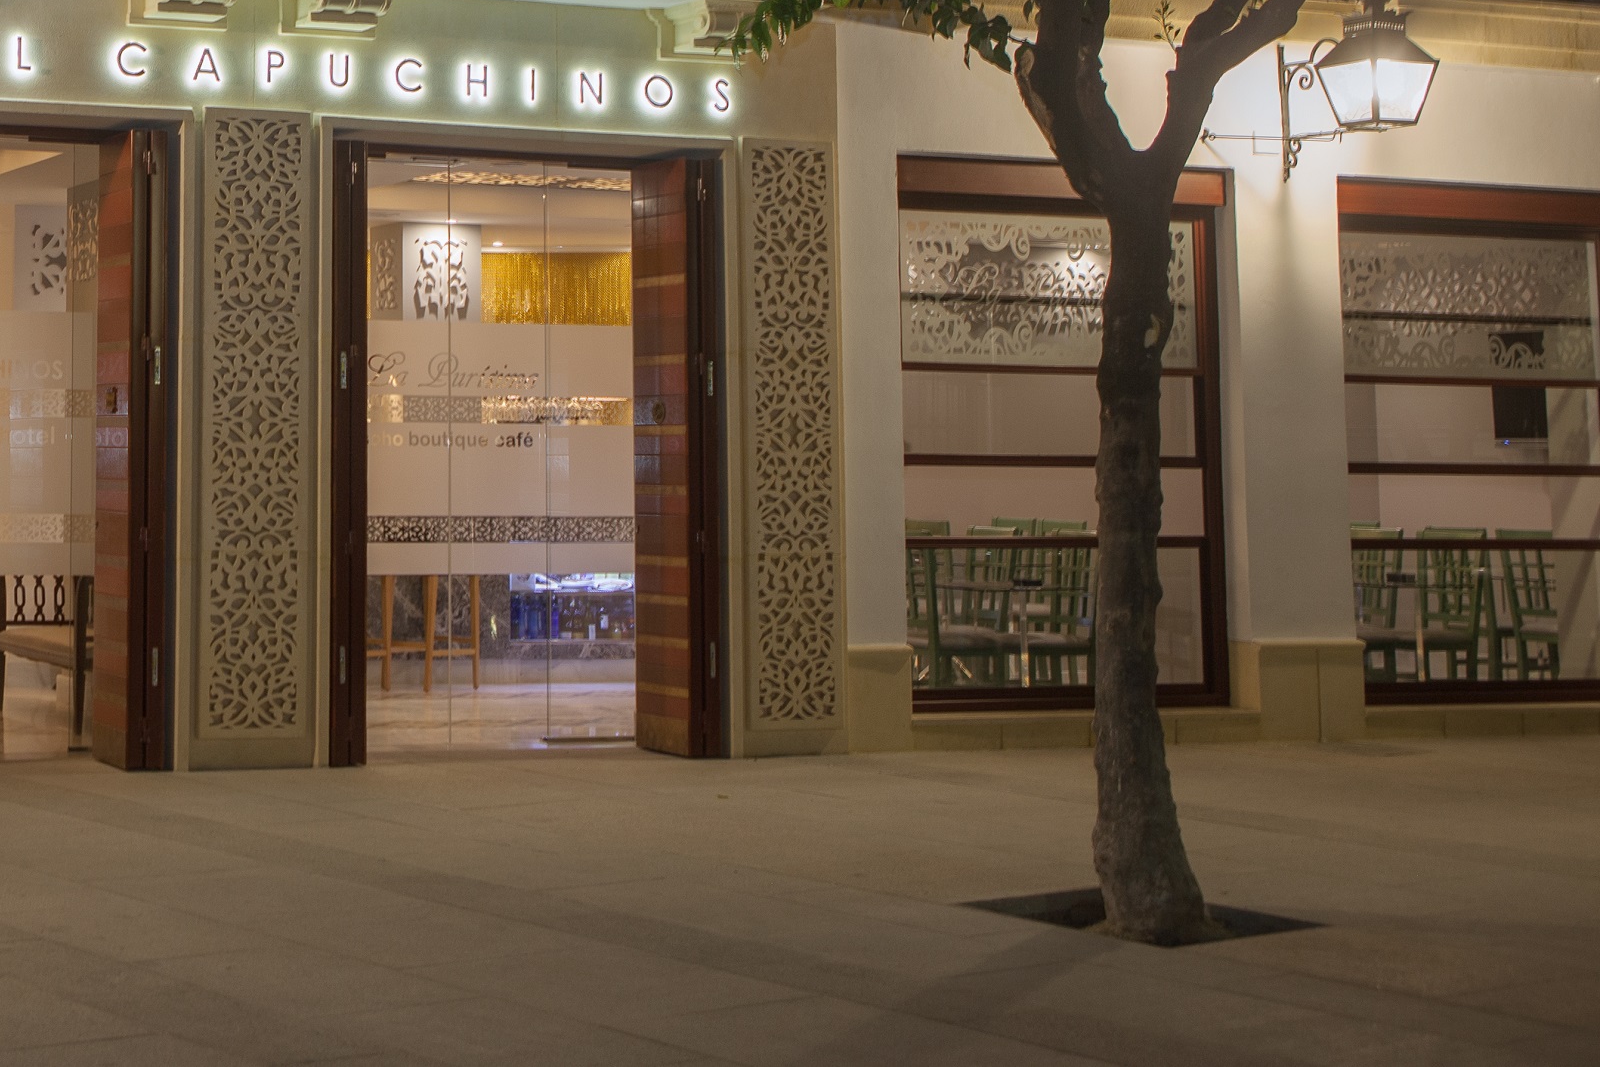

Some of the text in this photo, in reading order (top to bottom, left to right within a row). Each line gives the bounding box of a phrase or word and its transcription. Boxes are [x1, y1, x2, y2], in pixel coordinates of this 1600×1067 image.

[115, 41, 730, 113] CAPUCHINOS
[367, 350, 409, 388] La
[408, 430, 489, 451] boutique
[494, 430, 535, 448] café
